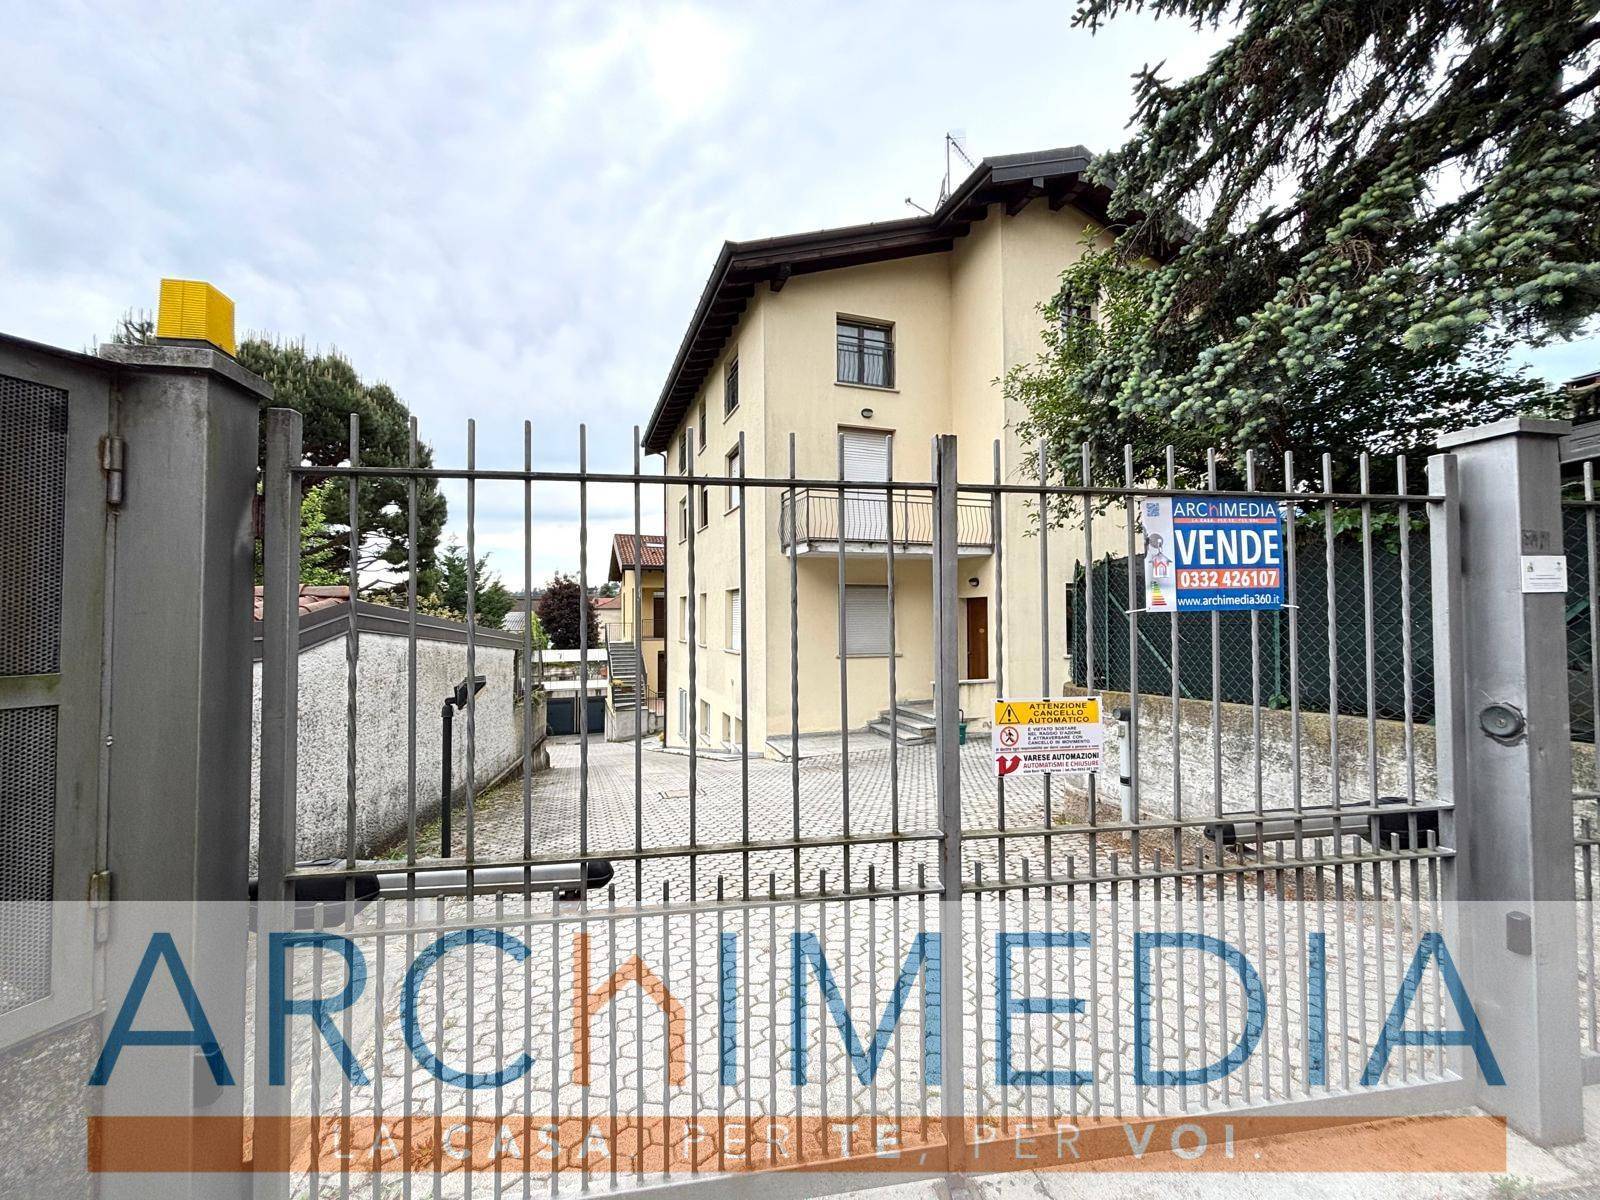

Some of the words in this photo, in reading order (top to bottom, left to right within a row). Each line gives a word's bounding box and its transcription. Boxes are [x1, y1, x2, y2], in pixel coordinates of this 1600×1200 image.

[1175, 529, 1280, 565] VENDE
[1180, 572, 1219, 587] 0332
[1222, 571, 1277, 587] 426107
[1177, 593, 1280, 606] www.archimedia360.it
[1033, 709, 1084, 717] CANCELLO
[1027, 716, 1089, 724] AUTOMATICO
[1052, 752, 1099, 760] AUTOMAZIONI
